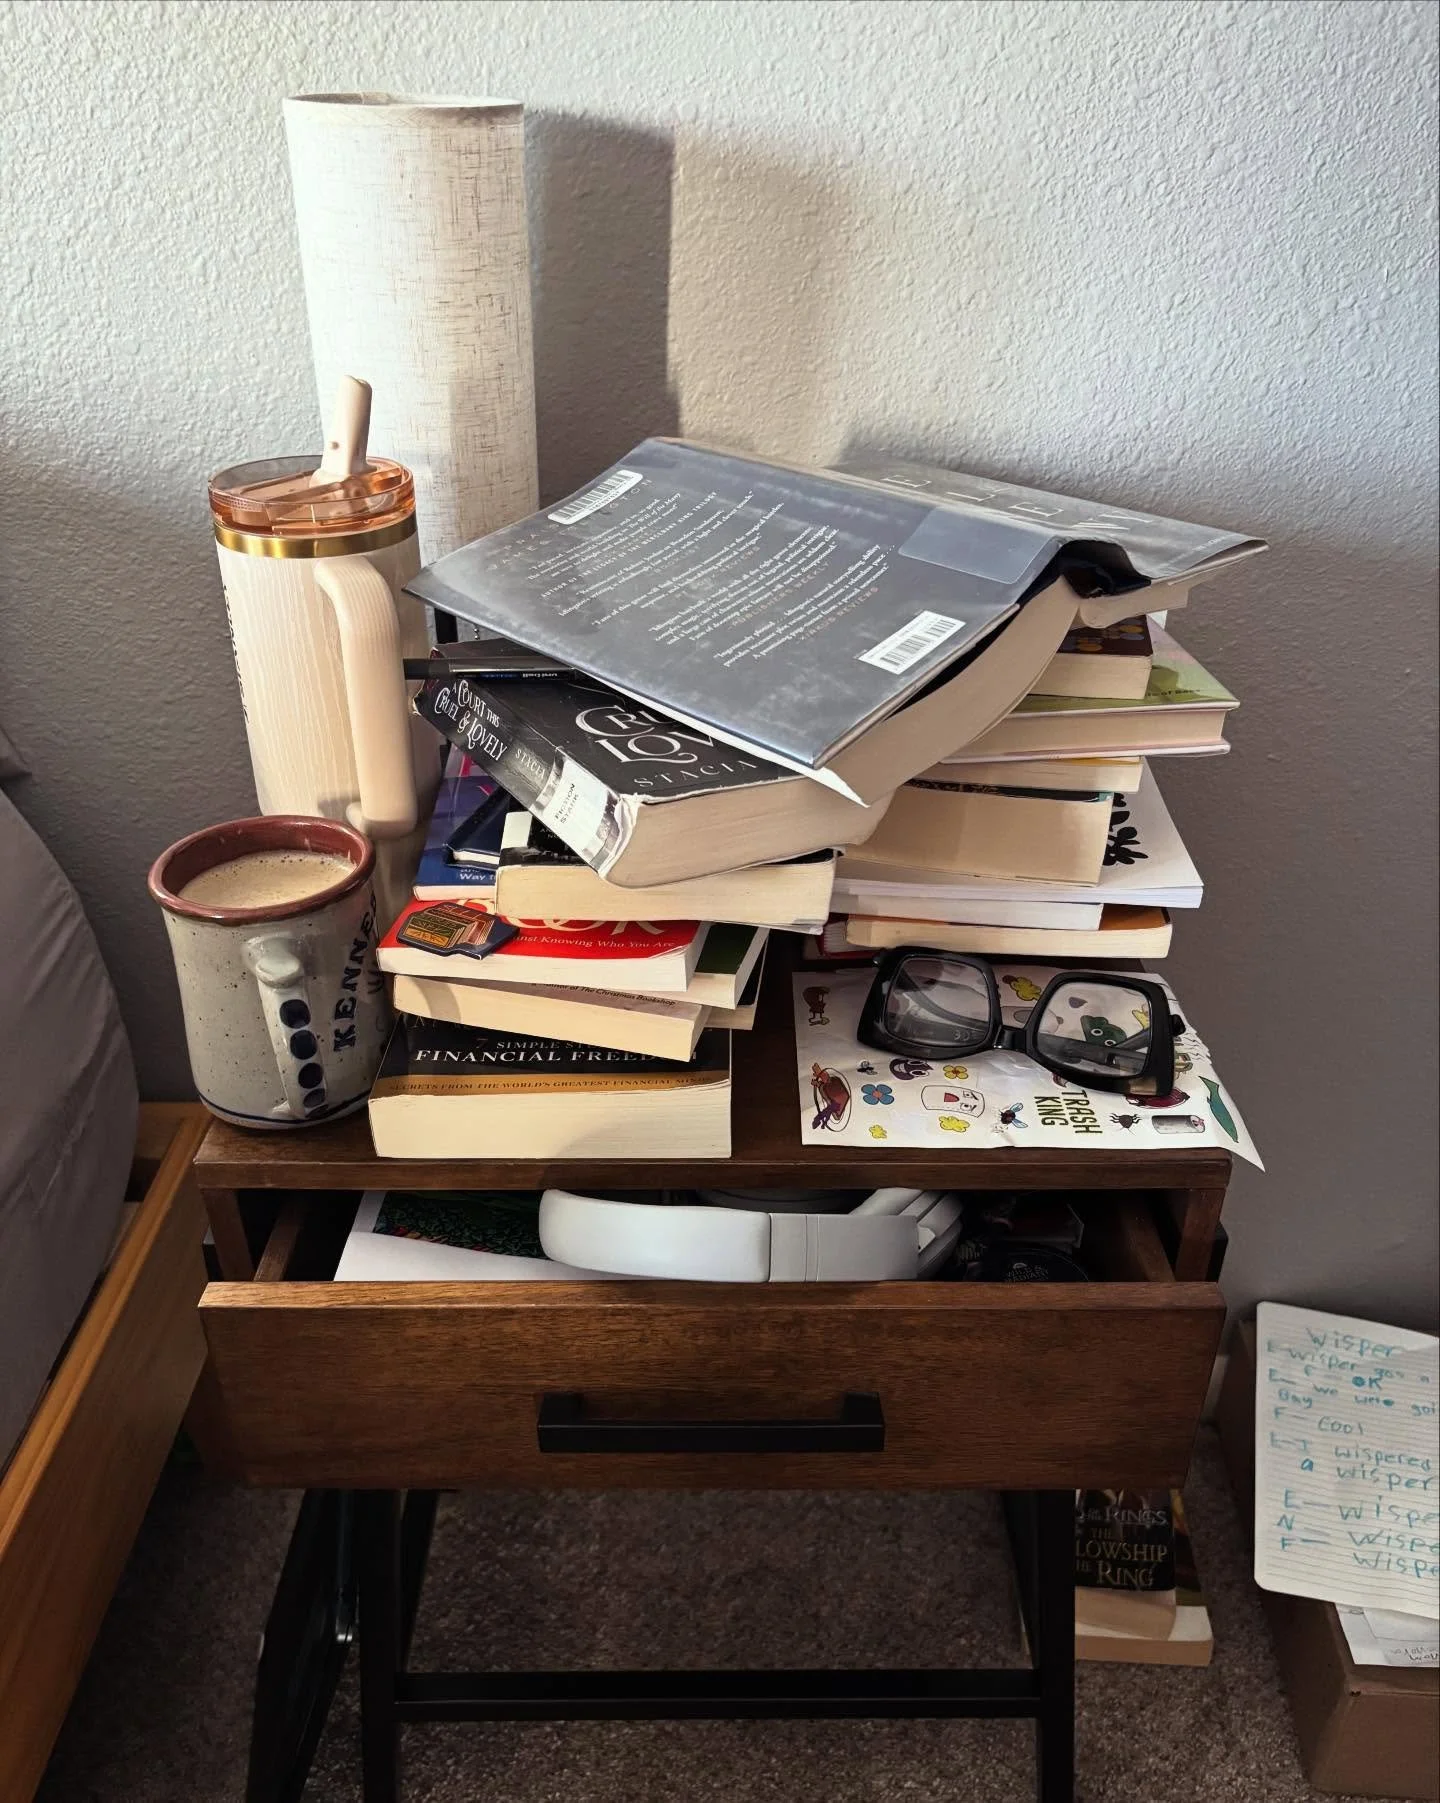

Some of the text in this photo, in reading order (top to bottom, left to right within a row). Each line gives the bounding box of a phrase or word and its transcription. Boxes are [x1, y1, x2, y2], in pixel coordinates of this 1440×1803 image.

[452, 679, 500, 728] A COURT THIS
[434, 687, 507, 761] CRUEL & LOVELY
[594, 731, 714, 764] LOV
[634, 760, 757, 788] STACIA
[460, 873, 486, 881] Way
[541, 936, 593, 948] Knowing
[598, 940, 624, 948] Who
[595, 988, 636, 1000] Christmas
[636, 994, 676, 1006] Bookshop
[415, 1050, 561, 1062] FINANCIAL
[496, 1041, 560, 1049] SIMPLE
[1034, 1096, 1069, 1126] KING
[1061, 1089, 1103, 1134] TRASH
[1096, 1559, 1153, 1587] RING
